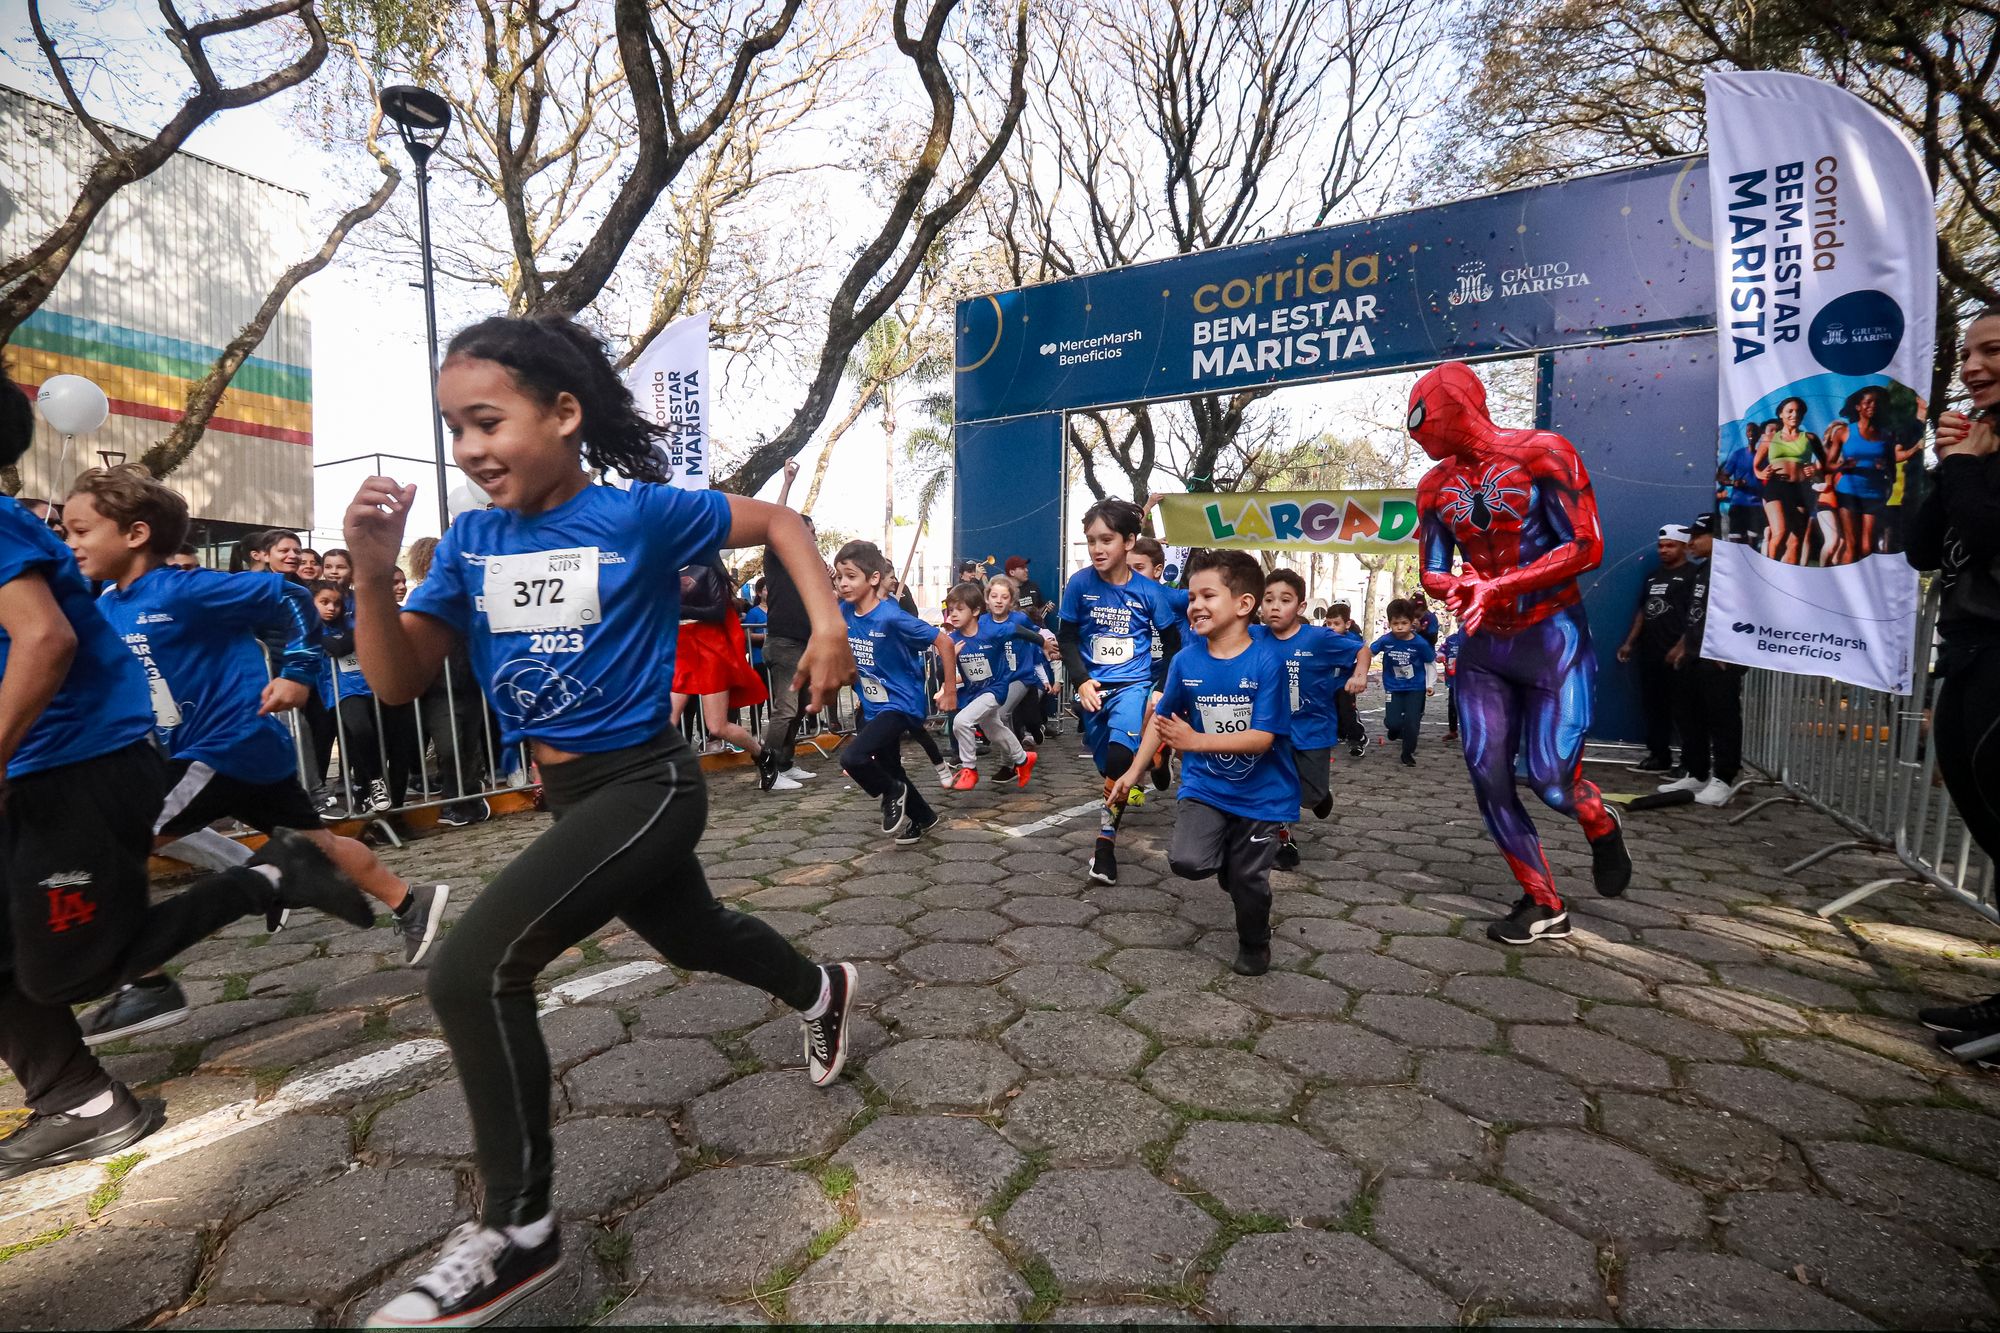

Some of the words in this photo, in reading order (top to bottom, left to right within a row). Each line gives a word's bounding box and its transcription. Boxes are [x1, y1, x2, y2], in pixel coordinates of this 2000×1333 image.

[1813, 156, 1845, 272] corrida
[1773, 161, 1804, 344] BEM-ESTAR
[1501, 261, 1569, 283] GRUPO
[1728, 168, 1767, 365] MARISTA
[1193, 250, 1379, 313] corrida
[1500, 273, 1591, 297] MARISTA
[1193, 294, 1377, 345] BEM-ESTAR
[1059, 329, 1142, 353] MercerMarsh
[1851, 332, 1893, 343] MARISTA
[1059, 347, 1122, 366] Beneficios
[1192, 325, 1376, 379] MARISTA
[683, 370, 703, 475] MARISTA
[1203, 496, 1420, 544] LARGAD
[513, 578, 565, 608] 372
[529, 634, 584, 654] 2023
[1758, 625, 1867, 651] MercerMarsh
[1100, 646, 1123, 656] 340
[1757, 640, 1842, 662] Beneficios
[968, 668, 984, 676] 346
[1197, 694, 1229, 703] corrida
[1230, 695, 1251, 703] kids
[1215, 719, 1247, 734] 360
